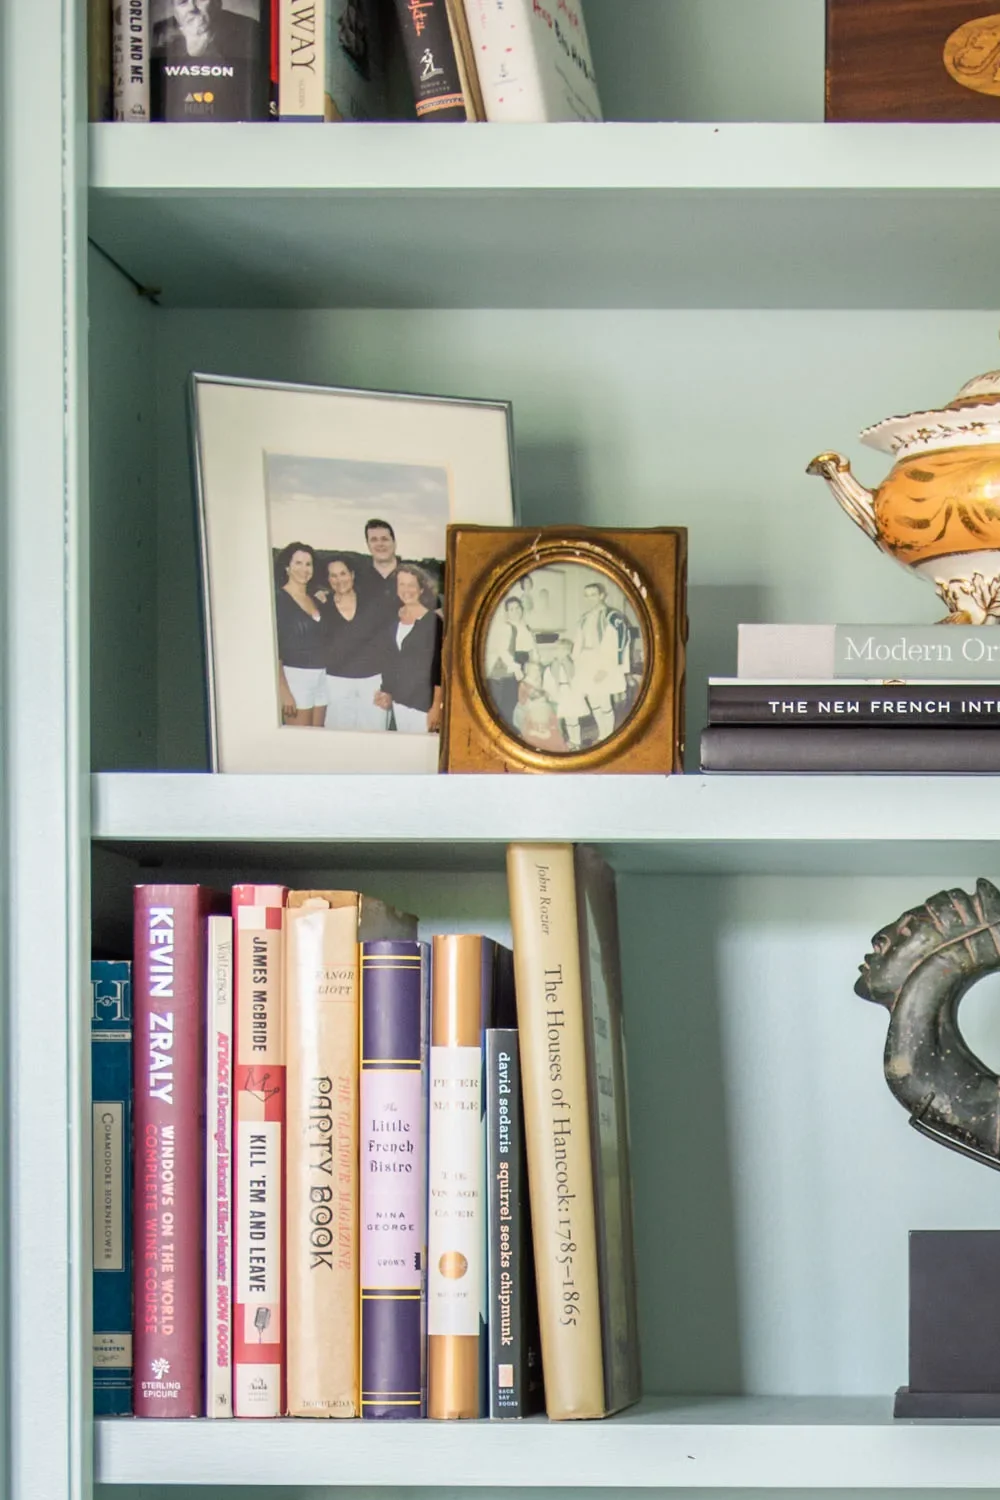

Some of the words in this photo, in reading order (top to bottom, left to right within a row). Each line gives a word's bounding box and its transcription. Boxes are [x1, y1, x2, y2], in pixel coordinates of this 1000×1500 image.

[165, 66, 234, 77] WASSON
[844, 638, 952, 662] Modern
[769, 701, 808, 713] THE
[818, 701, 859, 713] NEW
[871, 701, 952, 713] FRENCH
[536, 865, 550, 892] John
[539, 897, 552, 935] Rozier
[149, 907, 173, 997] KEVIN
[252, 937, 267, 984] JAMES
[544, 964, 562, 1003] The
[253, 990, 267, 1051] McBRIDE
[150, 1012, 173, 1105] ZRALY
[547, 1010, 566, 1082] Houses
[497, 1052, 512, 1094] david
[550, 1088, 570, 1108] of
[310, 1076, 332, 1174] PARTY
[372, 1120, 410, 1133] Little
[499, 1099, 512, 1153] sedaris
[101, 1114, 115, 1184] COMMODORE
[161, 1125, 174, 1207] WINDOWS
[250, 1135, 265, 1169] KILL
[368, 1141, 414, 1154] French
[370, 1160, 412, 1173] Bistro
[551, 1118, 574, 1212] Hancock:
[250, 1175, 265, 1203] 'EM
[497, 1162, 512, 1221] squirrel
[103, 1189, 115, 1259] HORNBLOWER
[162, 1212, 173, 1236] ON
[249, 1211, 265, 1241] AND
[309, 1186, 333, 1271] BOOK
[162, 1243, 173, 1272] THE
[500, 1225, 512, 1268] seeks
[249, 1247, 265, 1292] LEAVE
[162, 1279, 174, 1336] WORLD
[498, 1272, 514, 1346] chipmunk
[142, 1382, 181, 1390] STERLING
